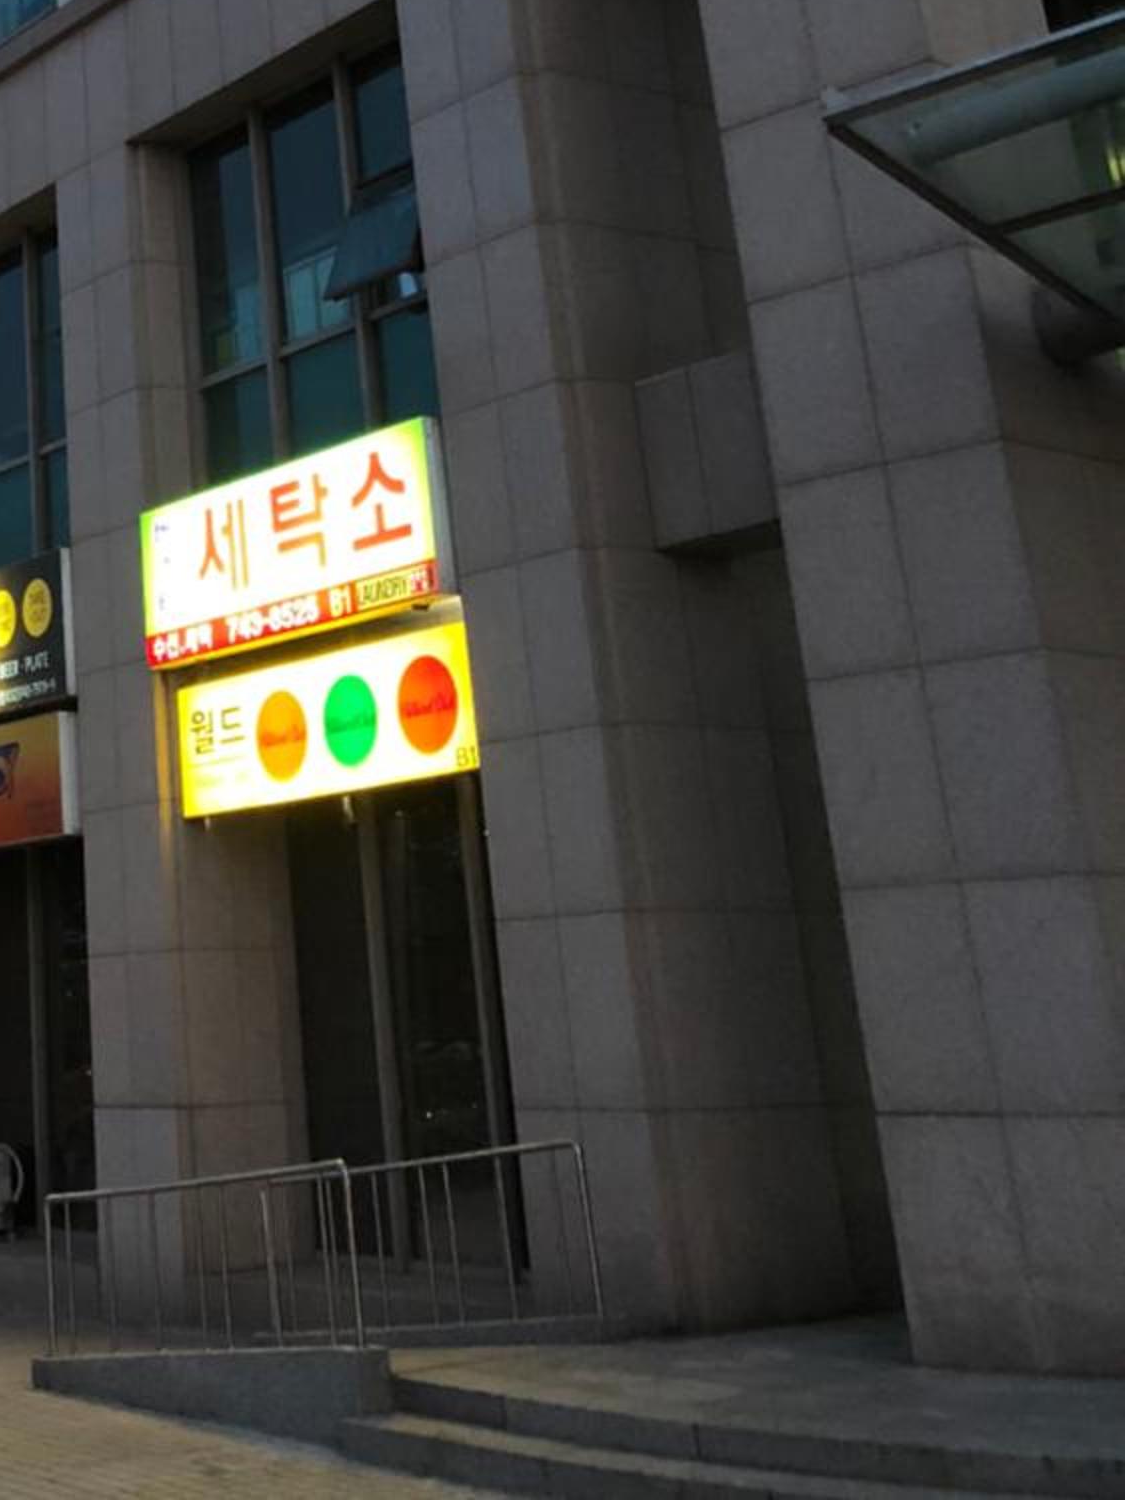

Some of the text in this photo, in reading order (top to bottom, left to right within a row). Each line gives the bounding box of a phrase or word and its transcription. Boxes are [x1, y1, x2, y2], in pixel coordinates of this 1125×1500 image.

[199, 451, 413, 591] 세탁소
[190, 706, 246, 755] 월드
[456, 747, 479, 768] B1
